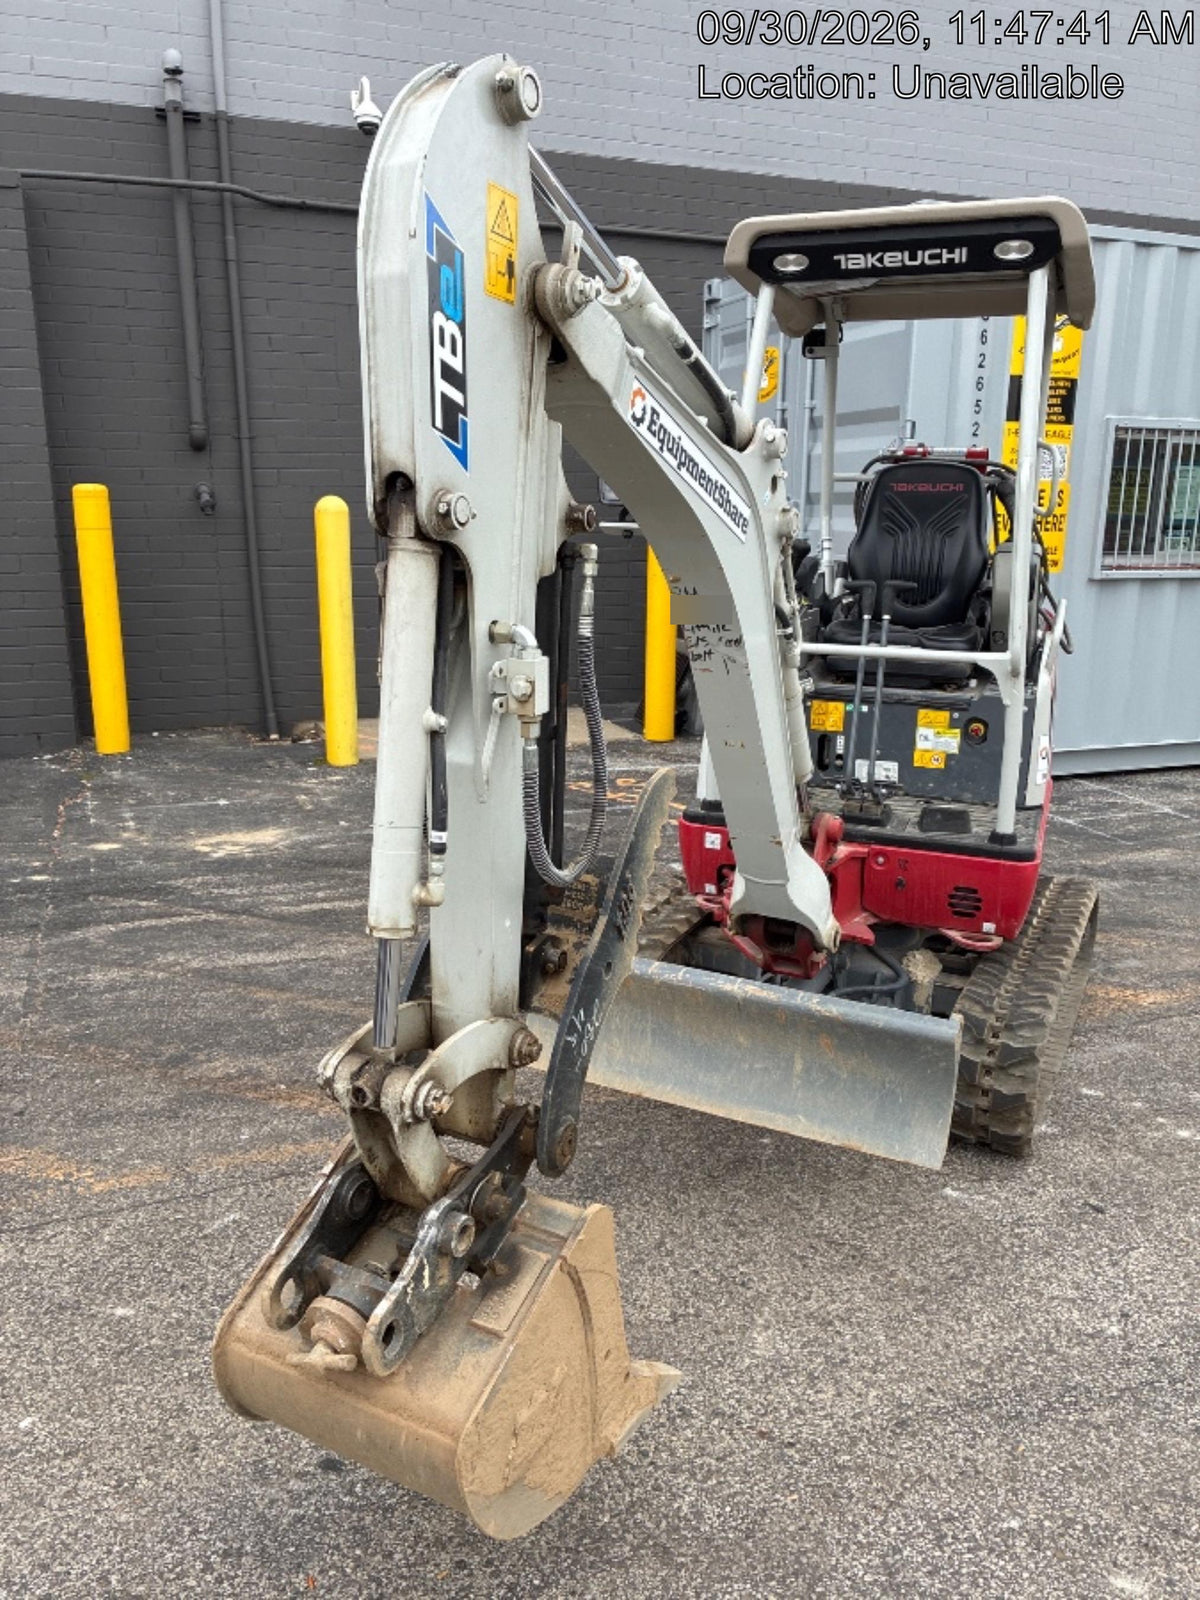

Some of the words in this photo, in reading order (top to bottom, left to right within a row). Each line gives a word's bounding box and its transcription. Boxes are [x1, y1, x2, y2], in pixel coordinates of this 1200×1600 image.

[833, 246, 968, 270] TAKEUCHI
[647, 406, 749, 534] EquipmentShare
[889, 483, 965, 492] TAKEUCHI
